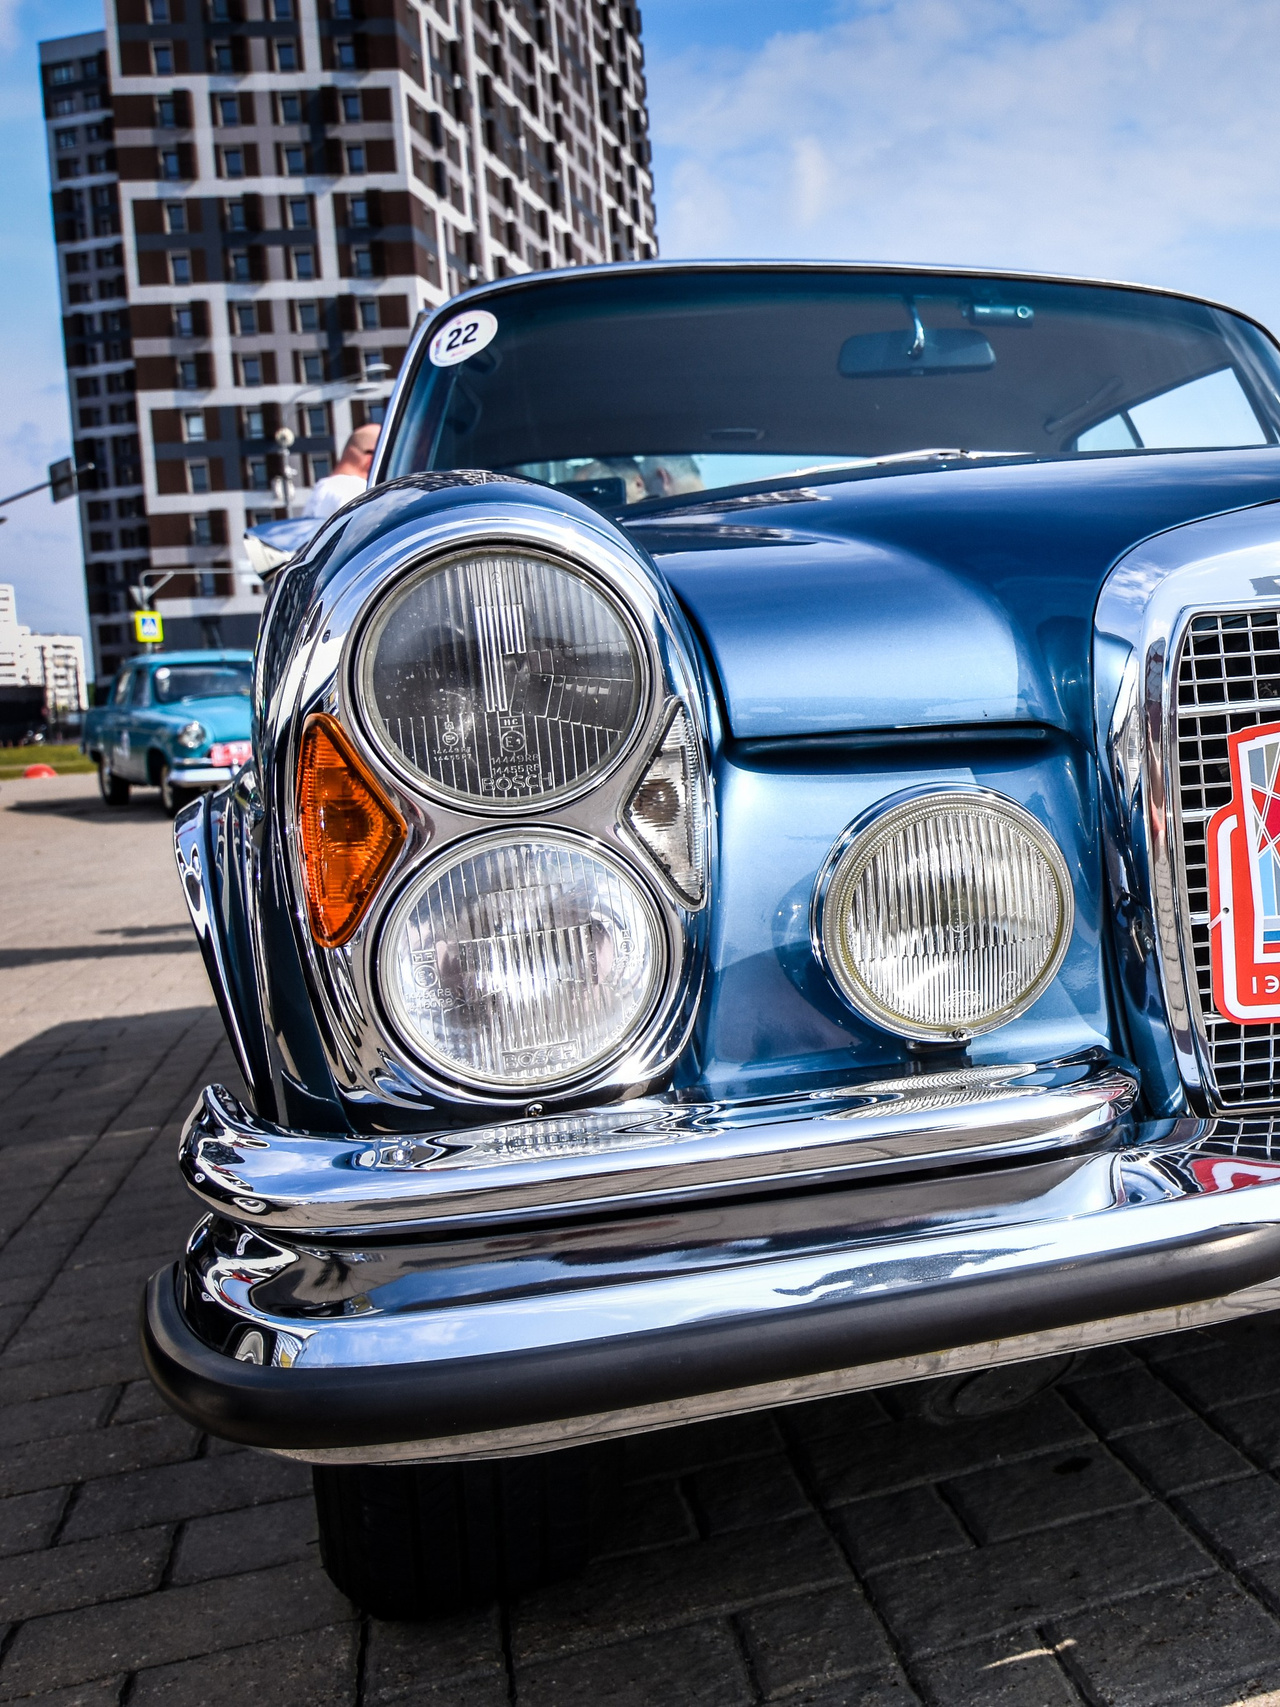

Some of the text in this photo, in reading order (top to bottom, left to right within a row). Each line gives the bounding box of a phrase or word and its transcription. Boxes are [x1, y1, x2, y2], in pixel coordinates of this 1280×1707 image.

[445, 322, 479, 352] 22
[482, 771, 553, 792] BOSCH
[503, 1043, 578, 1070] BOSCH
